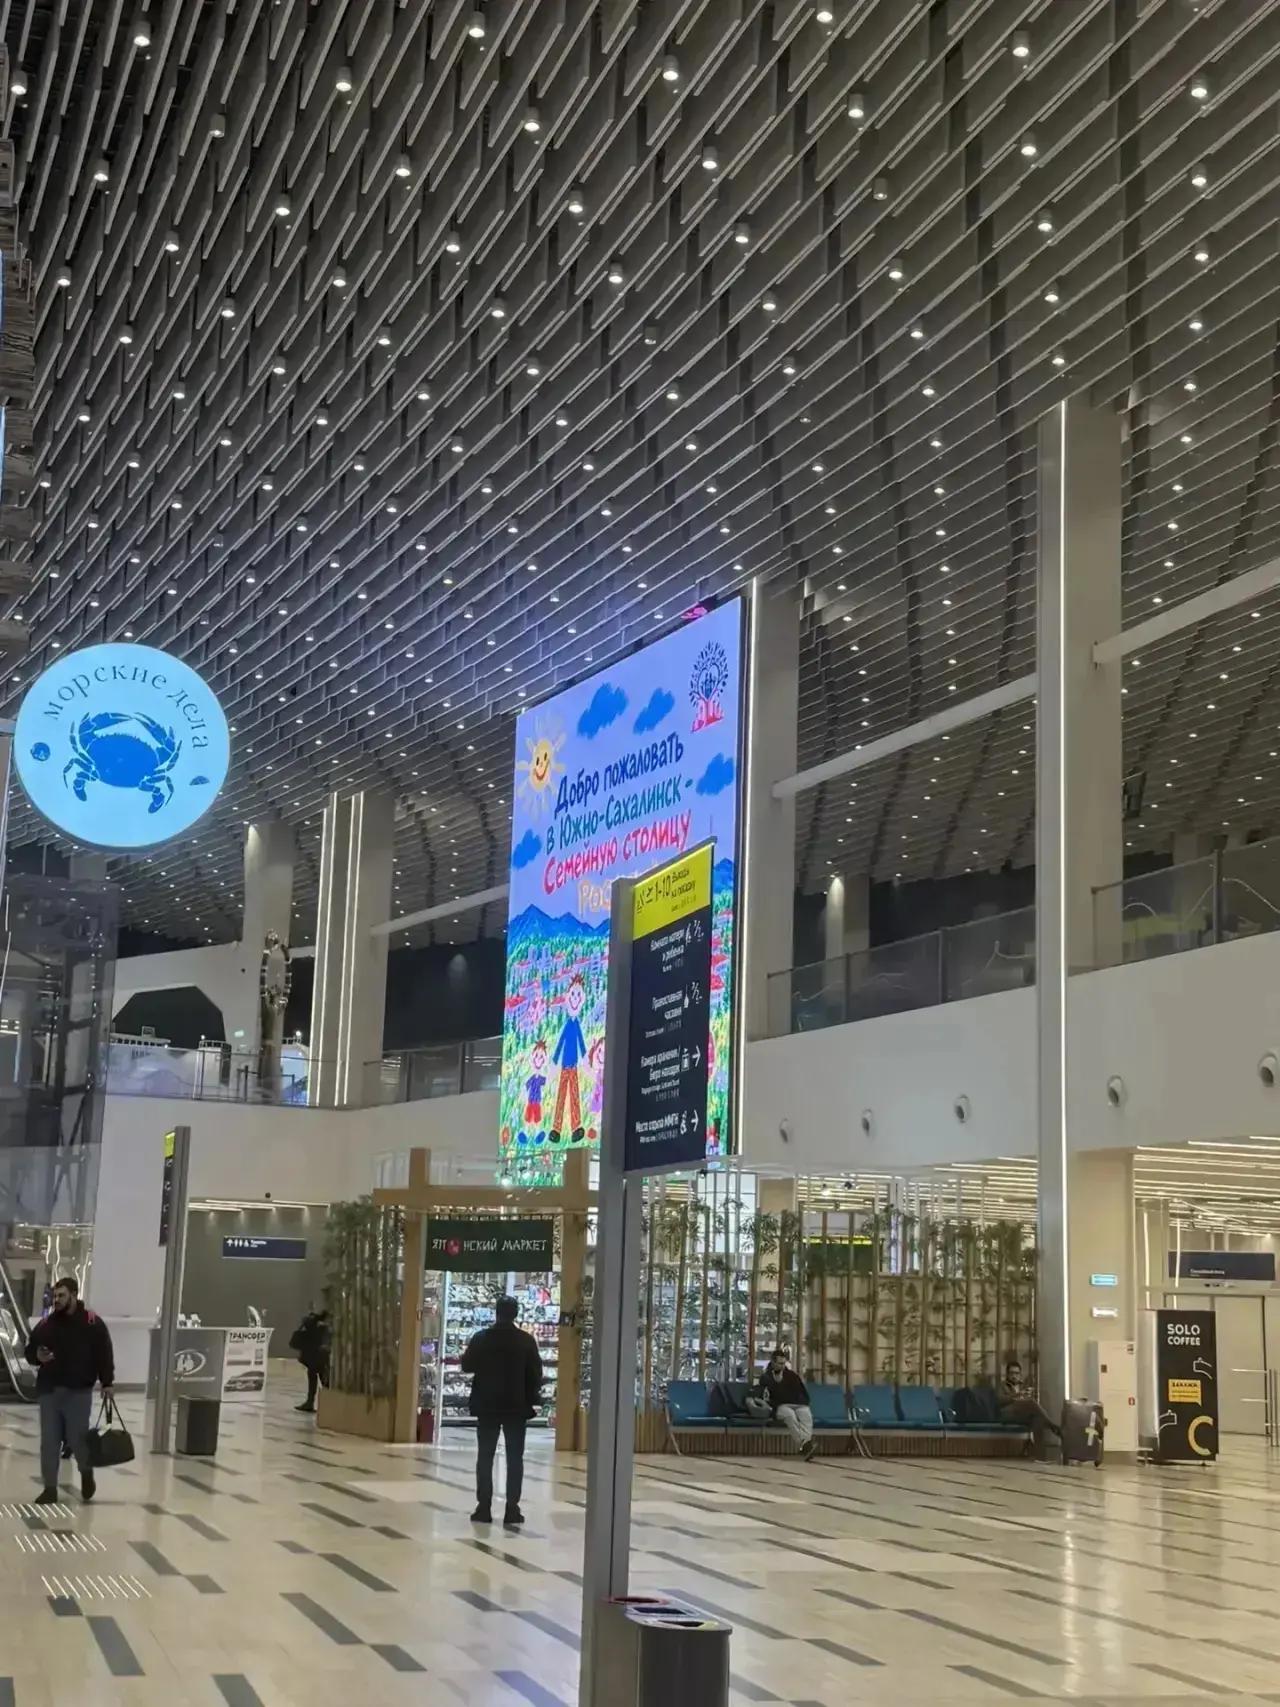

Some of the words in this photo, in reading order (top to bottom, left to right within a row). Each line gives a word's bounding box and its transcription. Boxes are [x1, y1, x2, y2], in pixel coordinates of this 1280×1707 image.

[554, 768, 600, 820] Добро
[603, 731, 684, 792] пожаловать
[546, 825, 554, 855] в
[560, 774, 682, 849] Южно-Сахалинск
[543, 837, 618, 895] Семейную
[501, 1239, 547, 1252] МАРКЕТ
[1167, 1323, 1201, 1336] SOLO
[1167, 1336, 1201, 1346] COFFEE
